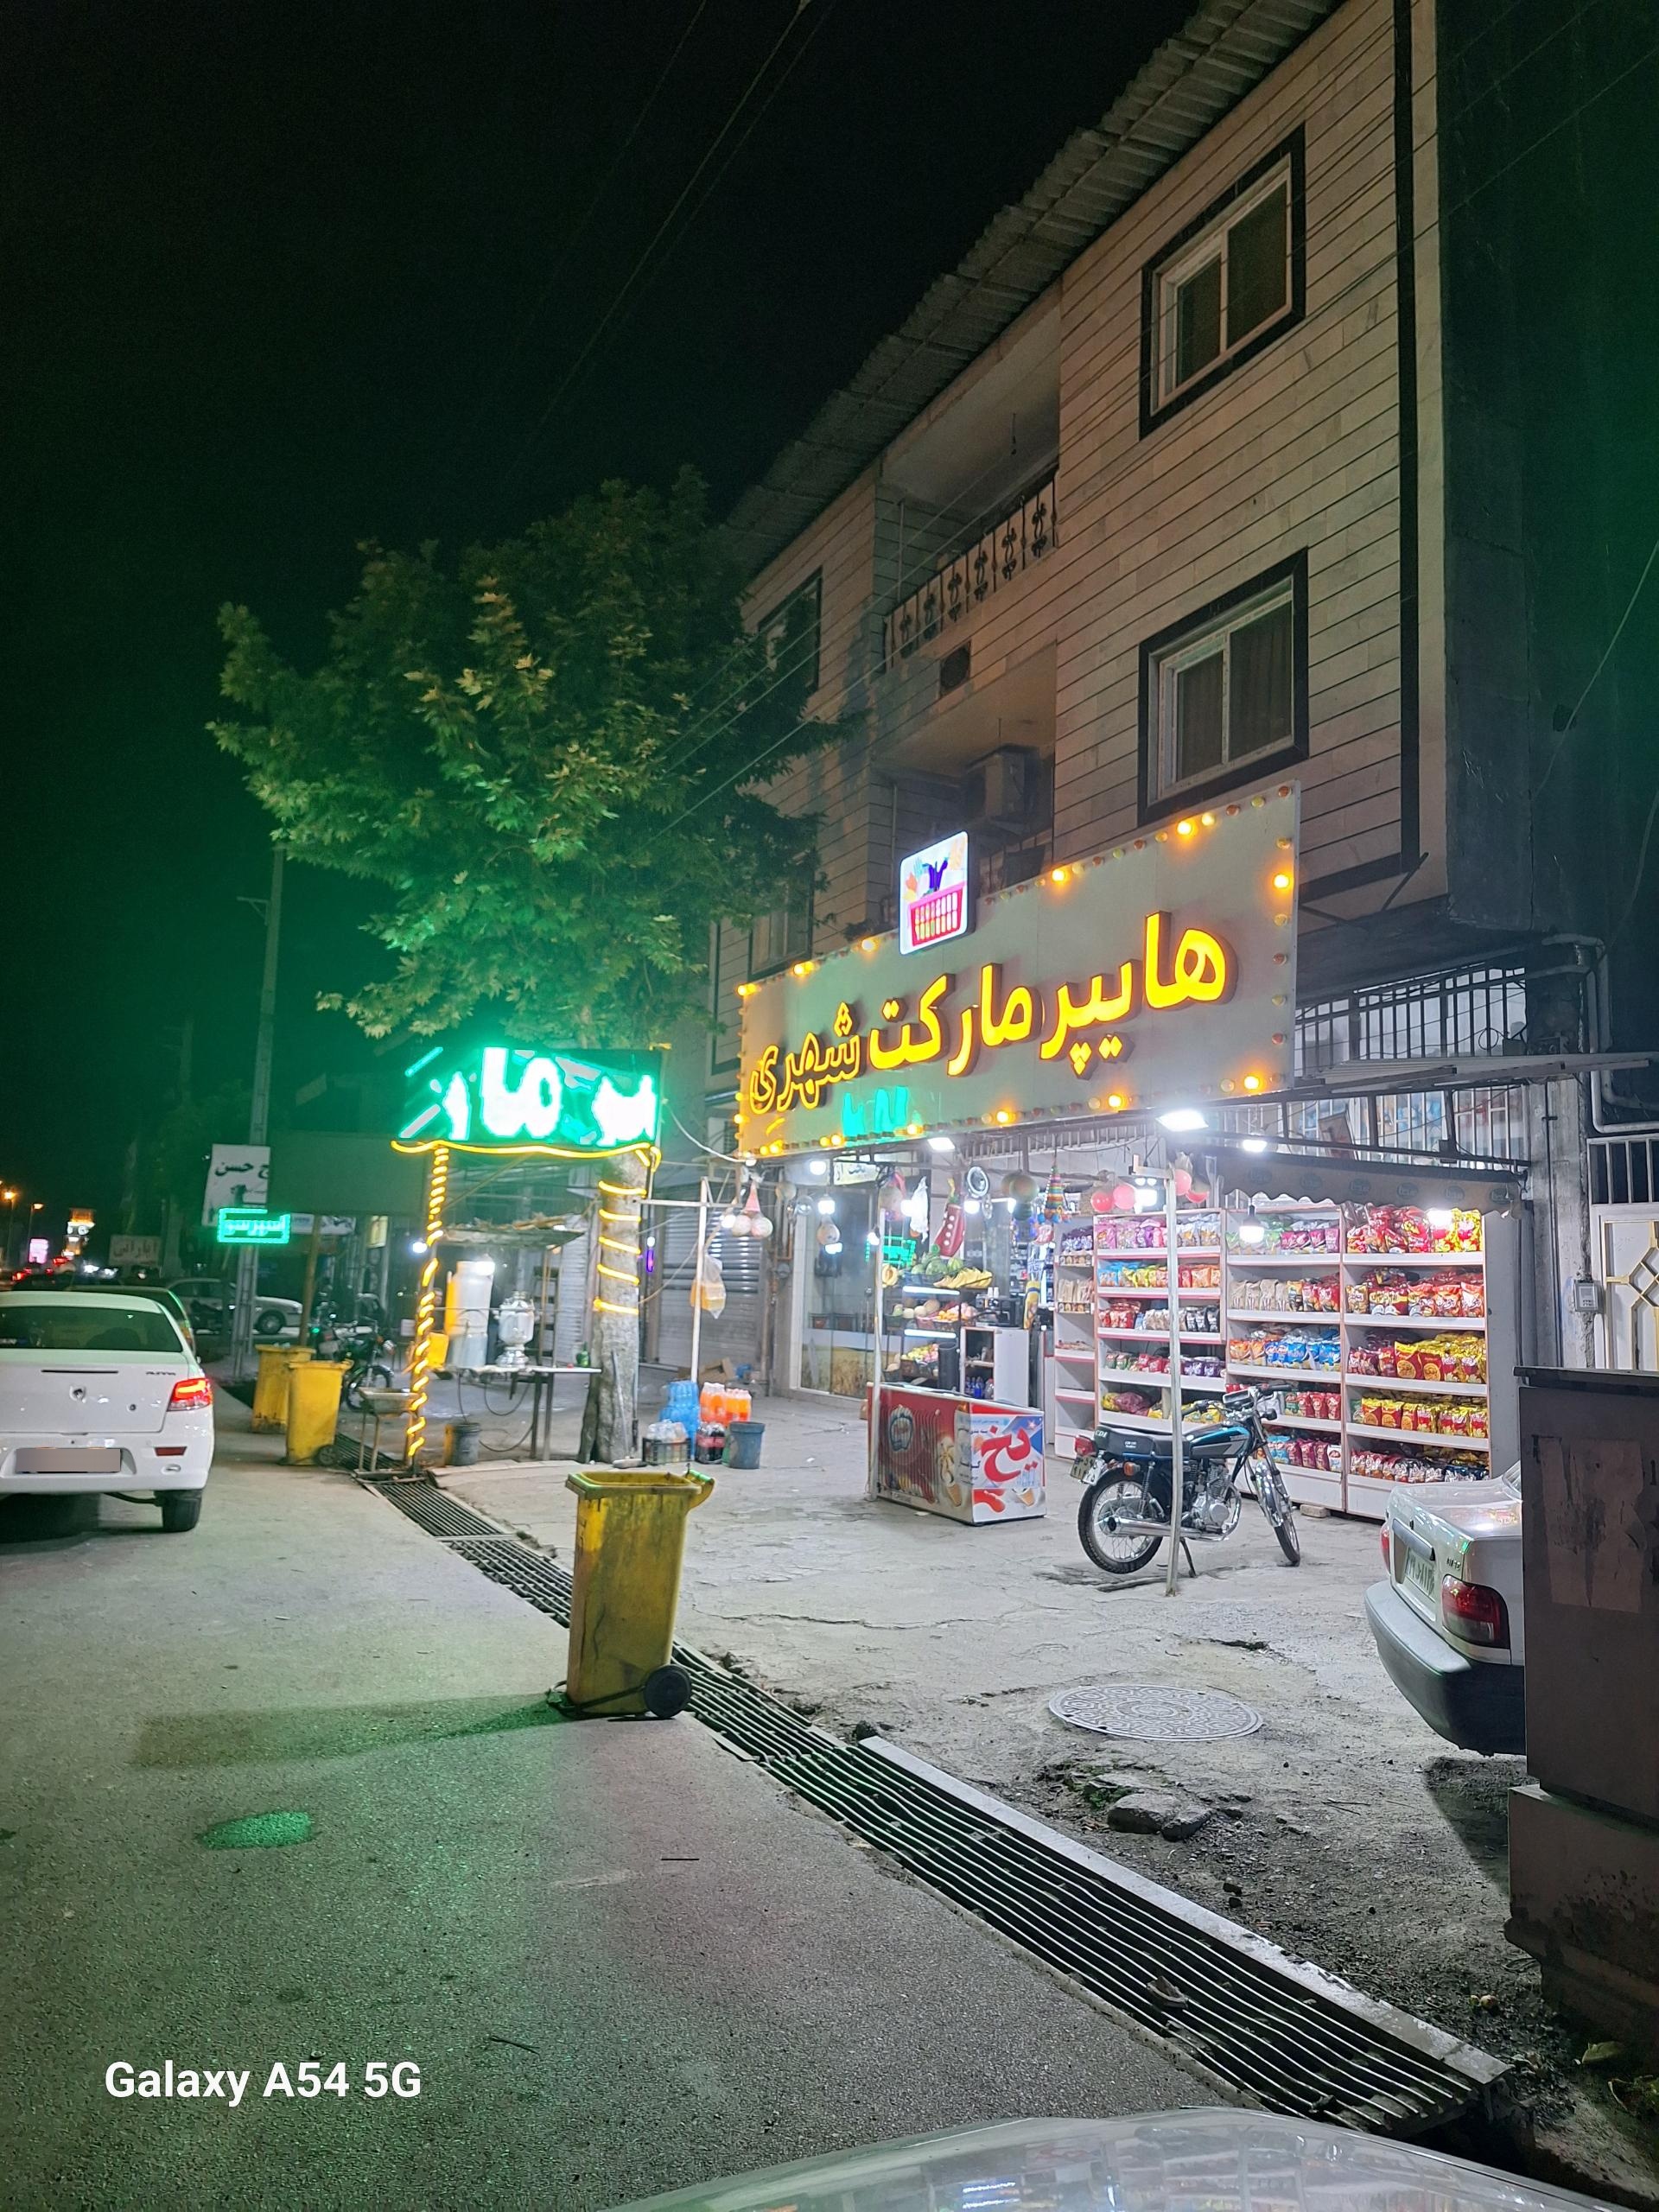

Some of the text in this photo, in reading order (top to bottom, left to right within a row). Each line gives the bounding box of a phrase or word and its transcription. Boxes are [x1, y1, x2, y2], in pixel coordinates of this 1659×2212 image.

[868, 964, 1033, 1077] مارکت
[1039, 912, 1227, 1076] هایپر
[748, 1001, 861, 1114] شهری
